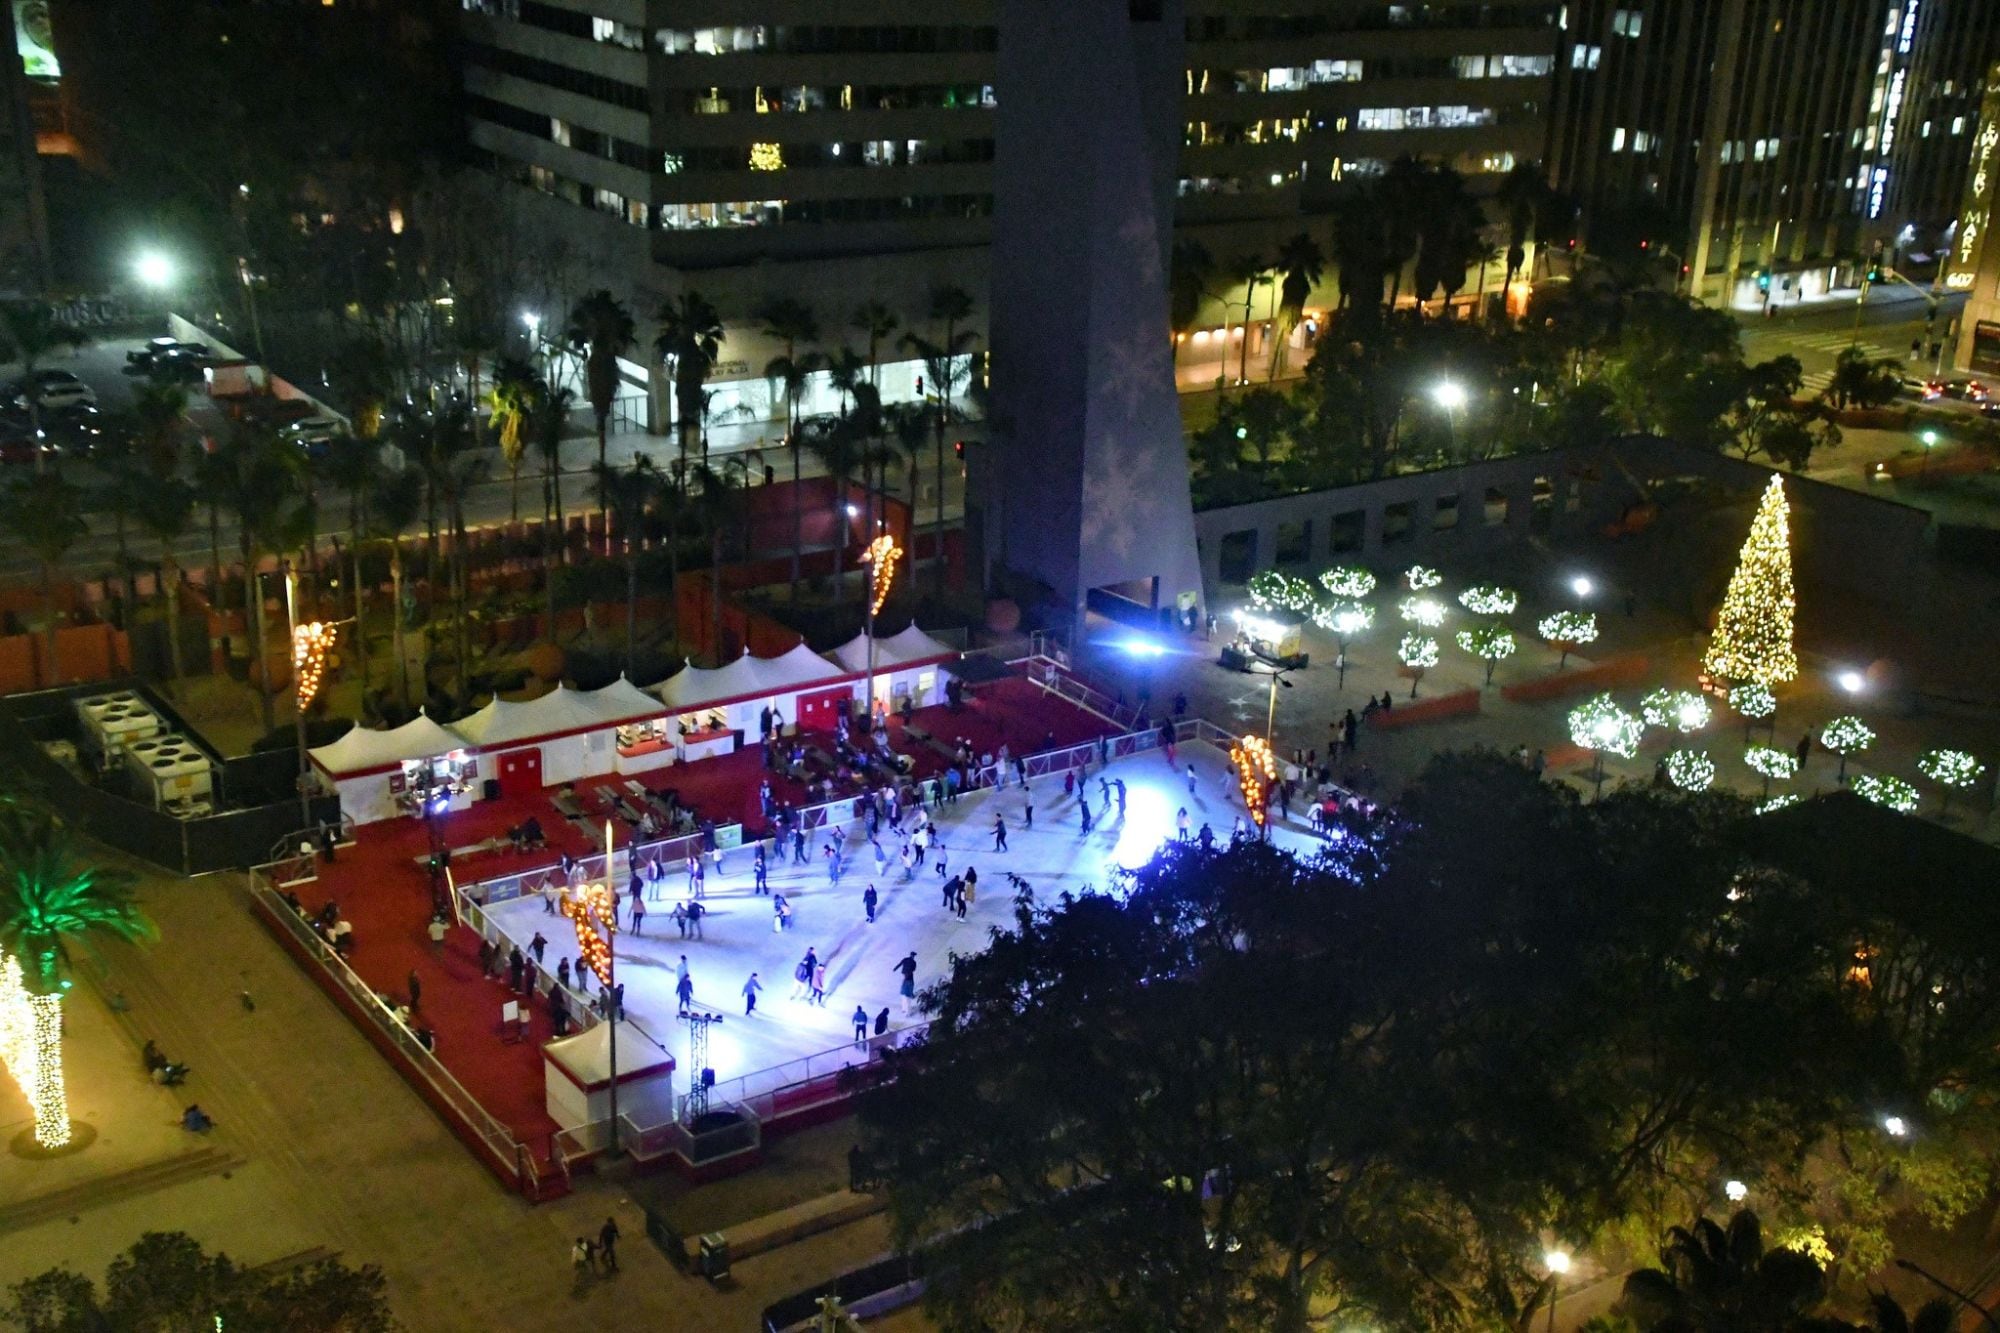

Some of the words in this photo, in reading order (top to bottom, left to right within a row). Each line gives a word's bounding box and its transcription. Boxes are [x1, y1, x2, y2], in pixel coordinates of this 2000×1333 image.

[1882, 67, 1905, 156] JEWELRY
[1870, 168, 1887, 219] MART
[1962, 211, 1981, 263] MART
[1946, 272, 1976, 287] 607
